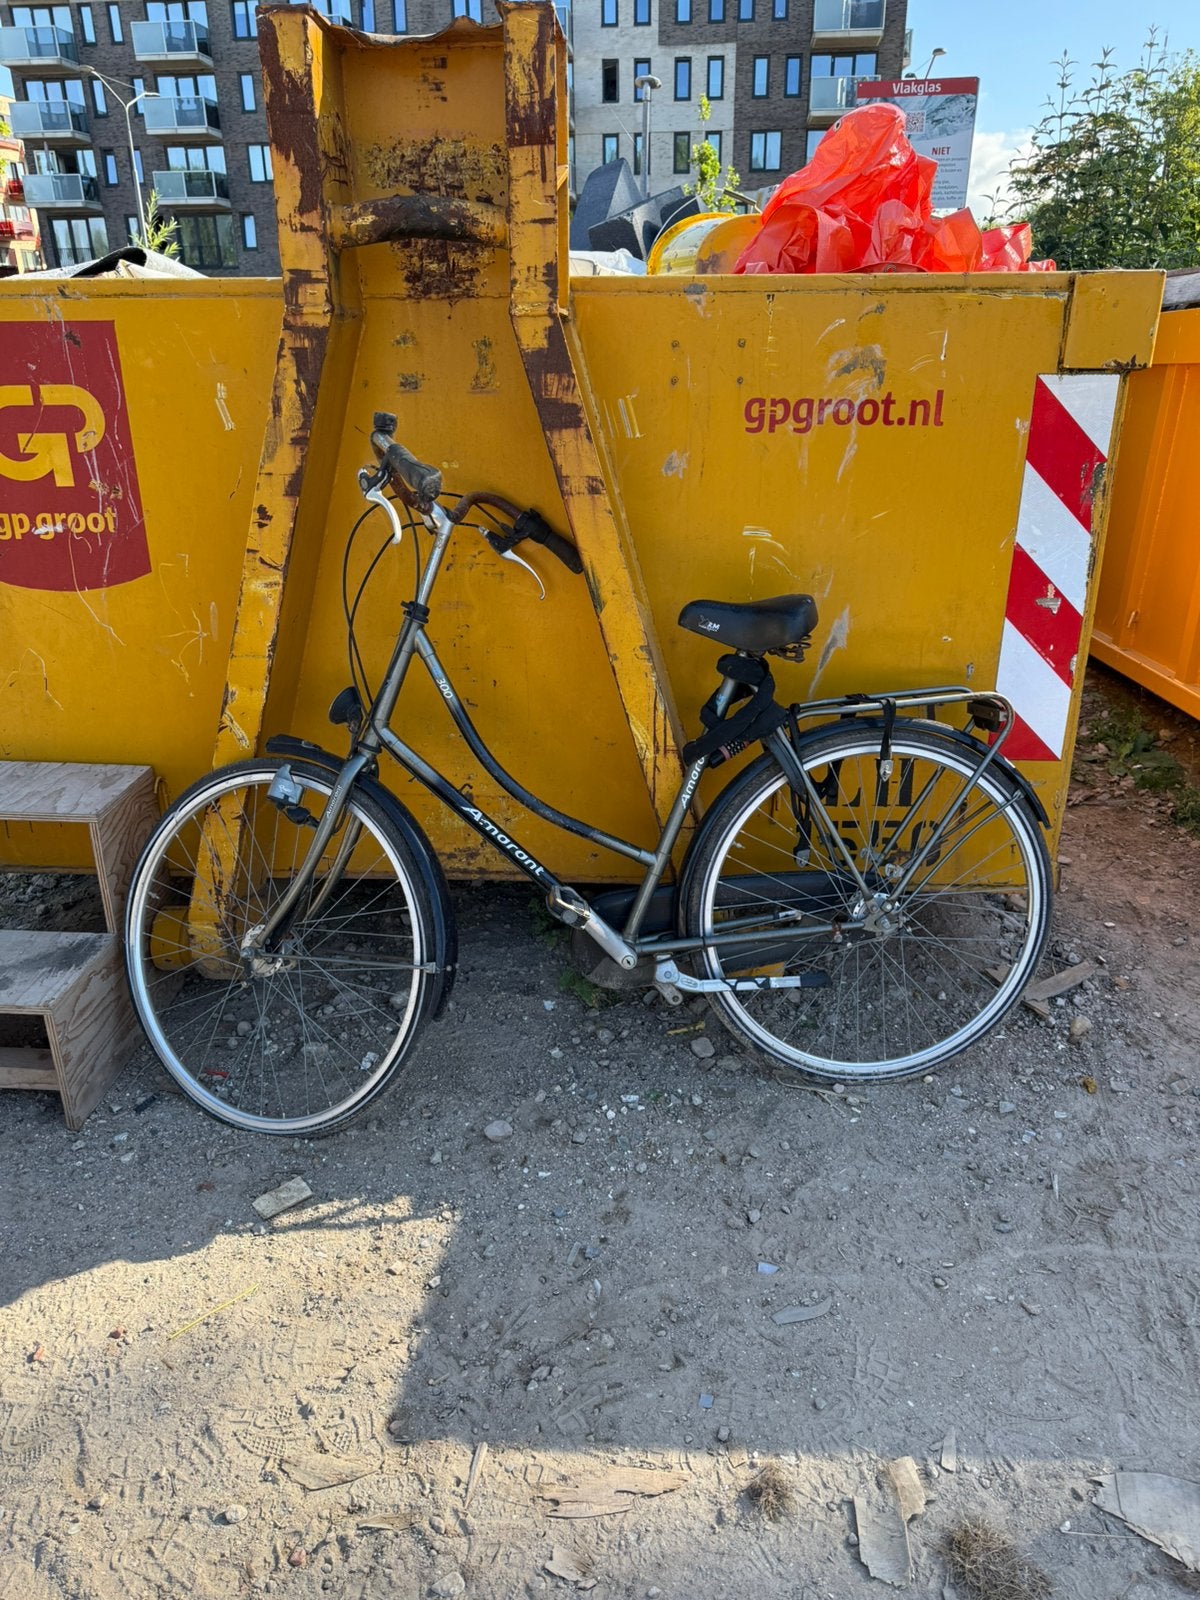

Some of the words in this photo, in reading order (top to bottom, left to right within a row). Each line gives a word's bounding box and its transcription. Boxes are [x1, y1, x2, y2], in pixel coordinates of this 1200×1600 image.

[892, 81, 942, 96] Vlakglas
[931, 146, 951, 155] NIET
[744, 389, 945, 434] gpgroot.nl
[36, 506, 118, 541] groot
[436, 678, 453, 699] 300
